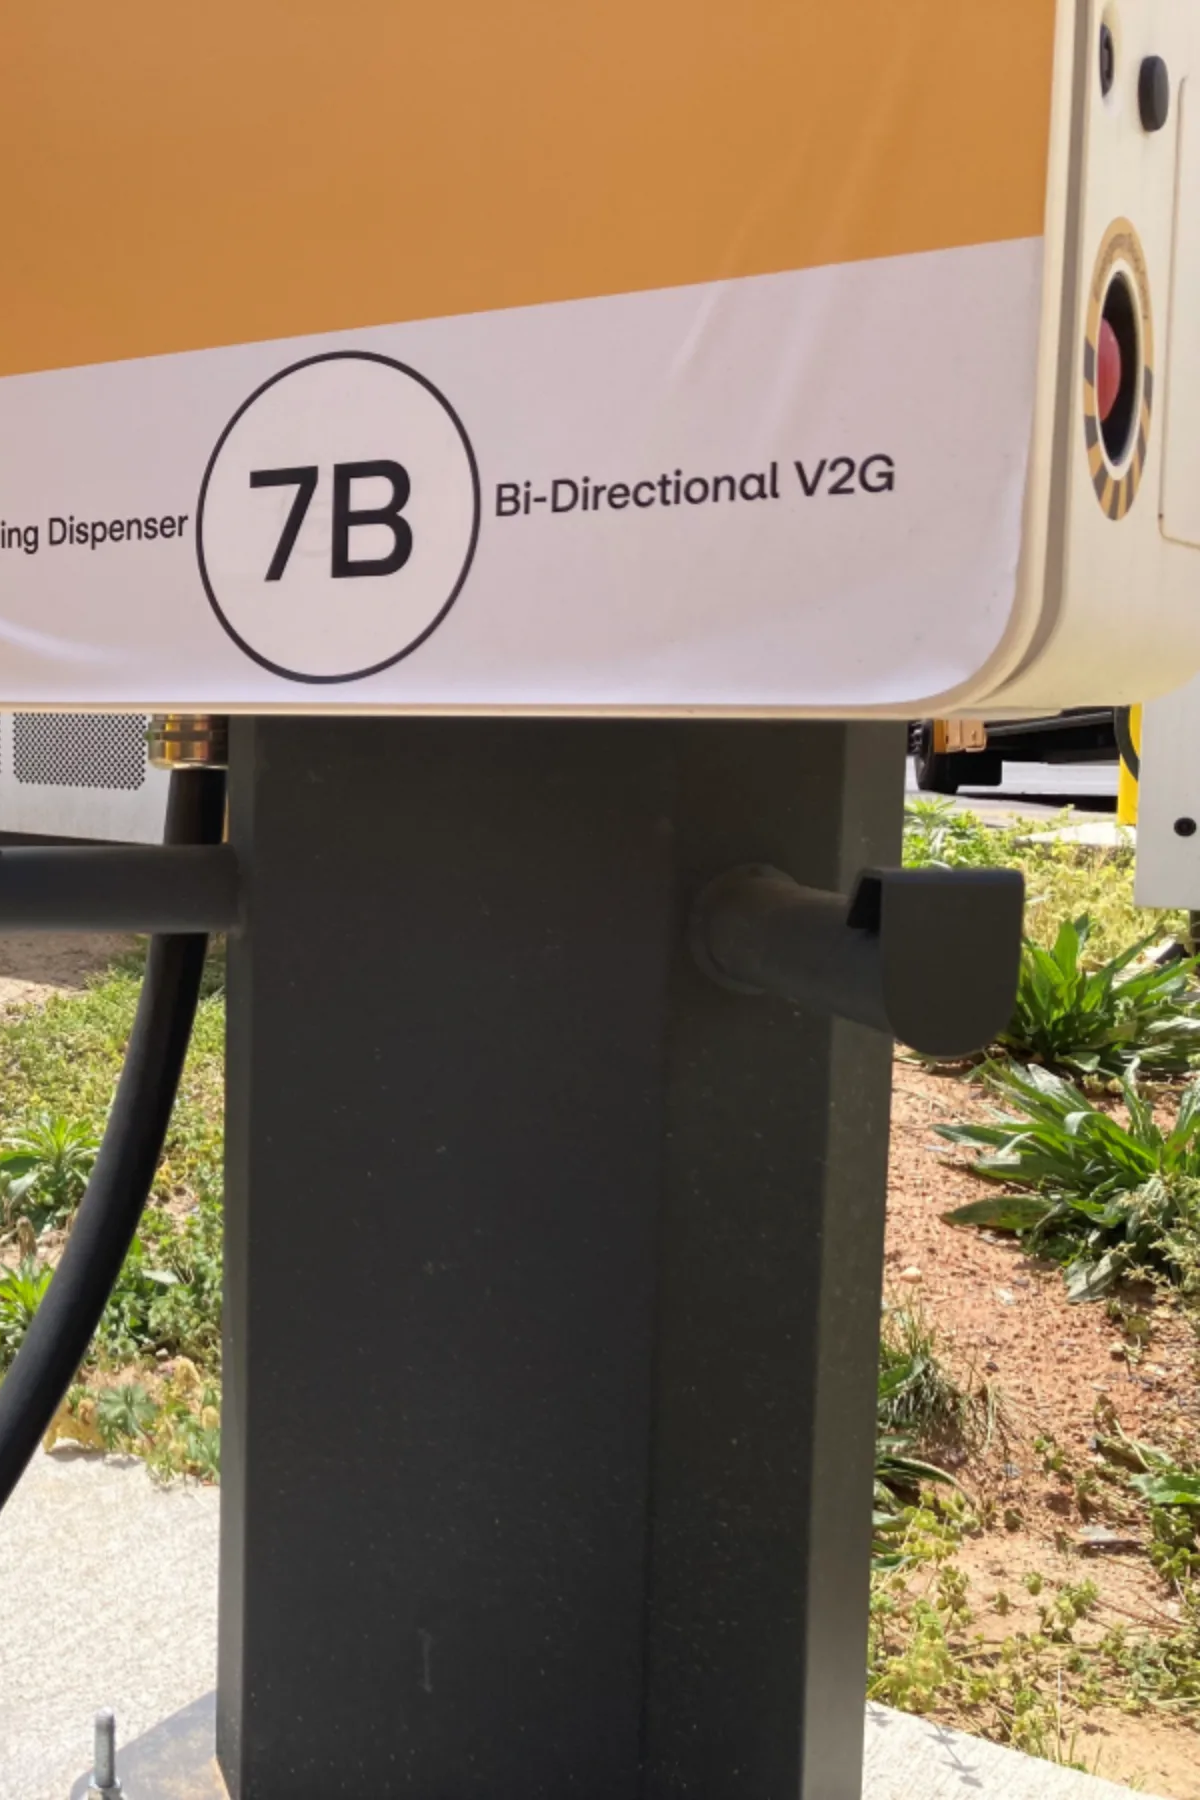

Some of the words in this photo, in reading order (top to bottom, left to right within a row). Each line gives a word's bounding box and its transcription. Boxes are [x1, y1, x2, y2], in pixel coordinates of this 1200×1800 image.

[495, 461, 780, 518] Bi-Directional
[794, 453, 894, 497] V2G
[49, 515, 190, 547] Dispenser
[249, 459, 413, 582] 7B
